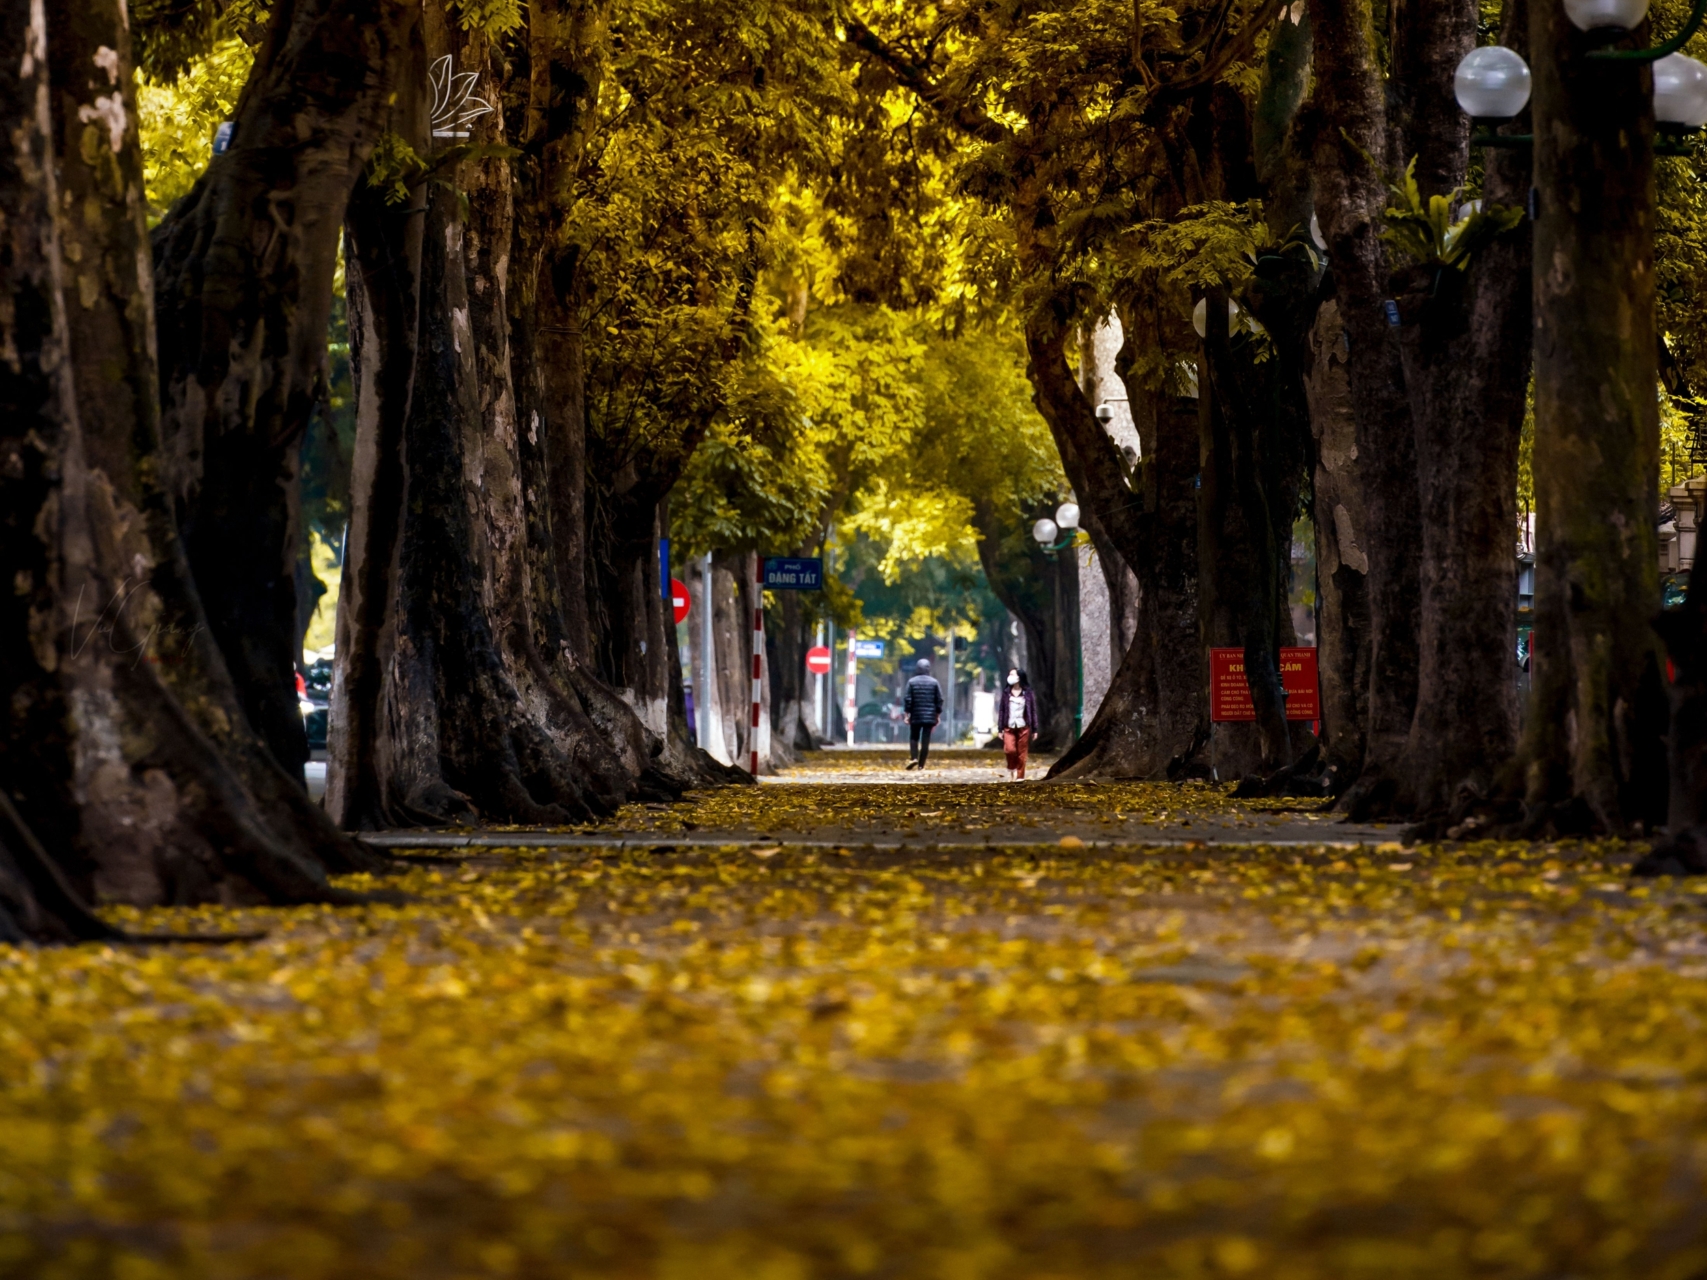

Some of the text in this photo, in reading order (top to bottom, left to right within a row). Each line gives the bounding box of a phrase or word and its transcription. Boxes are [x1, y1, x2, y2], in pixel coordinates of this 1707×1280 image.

[799, 570, 816, 584] TẤT
[1229, 661, 1302, 672] KH CẤM
